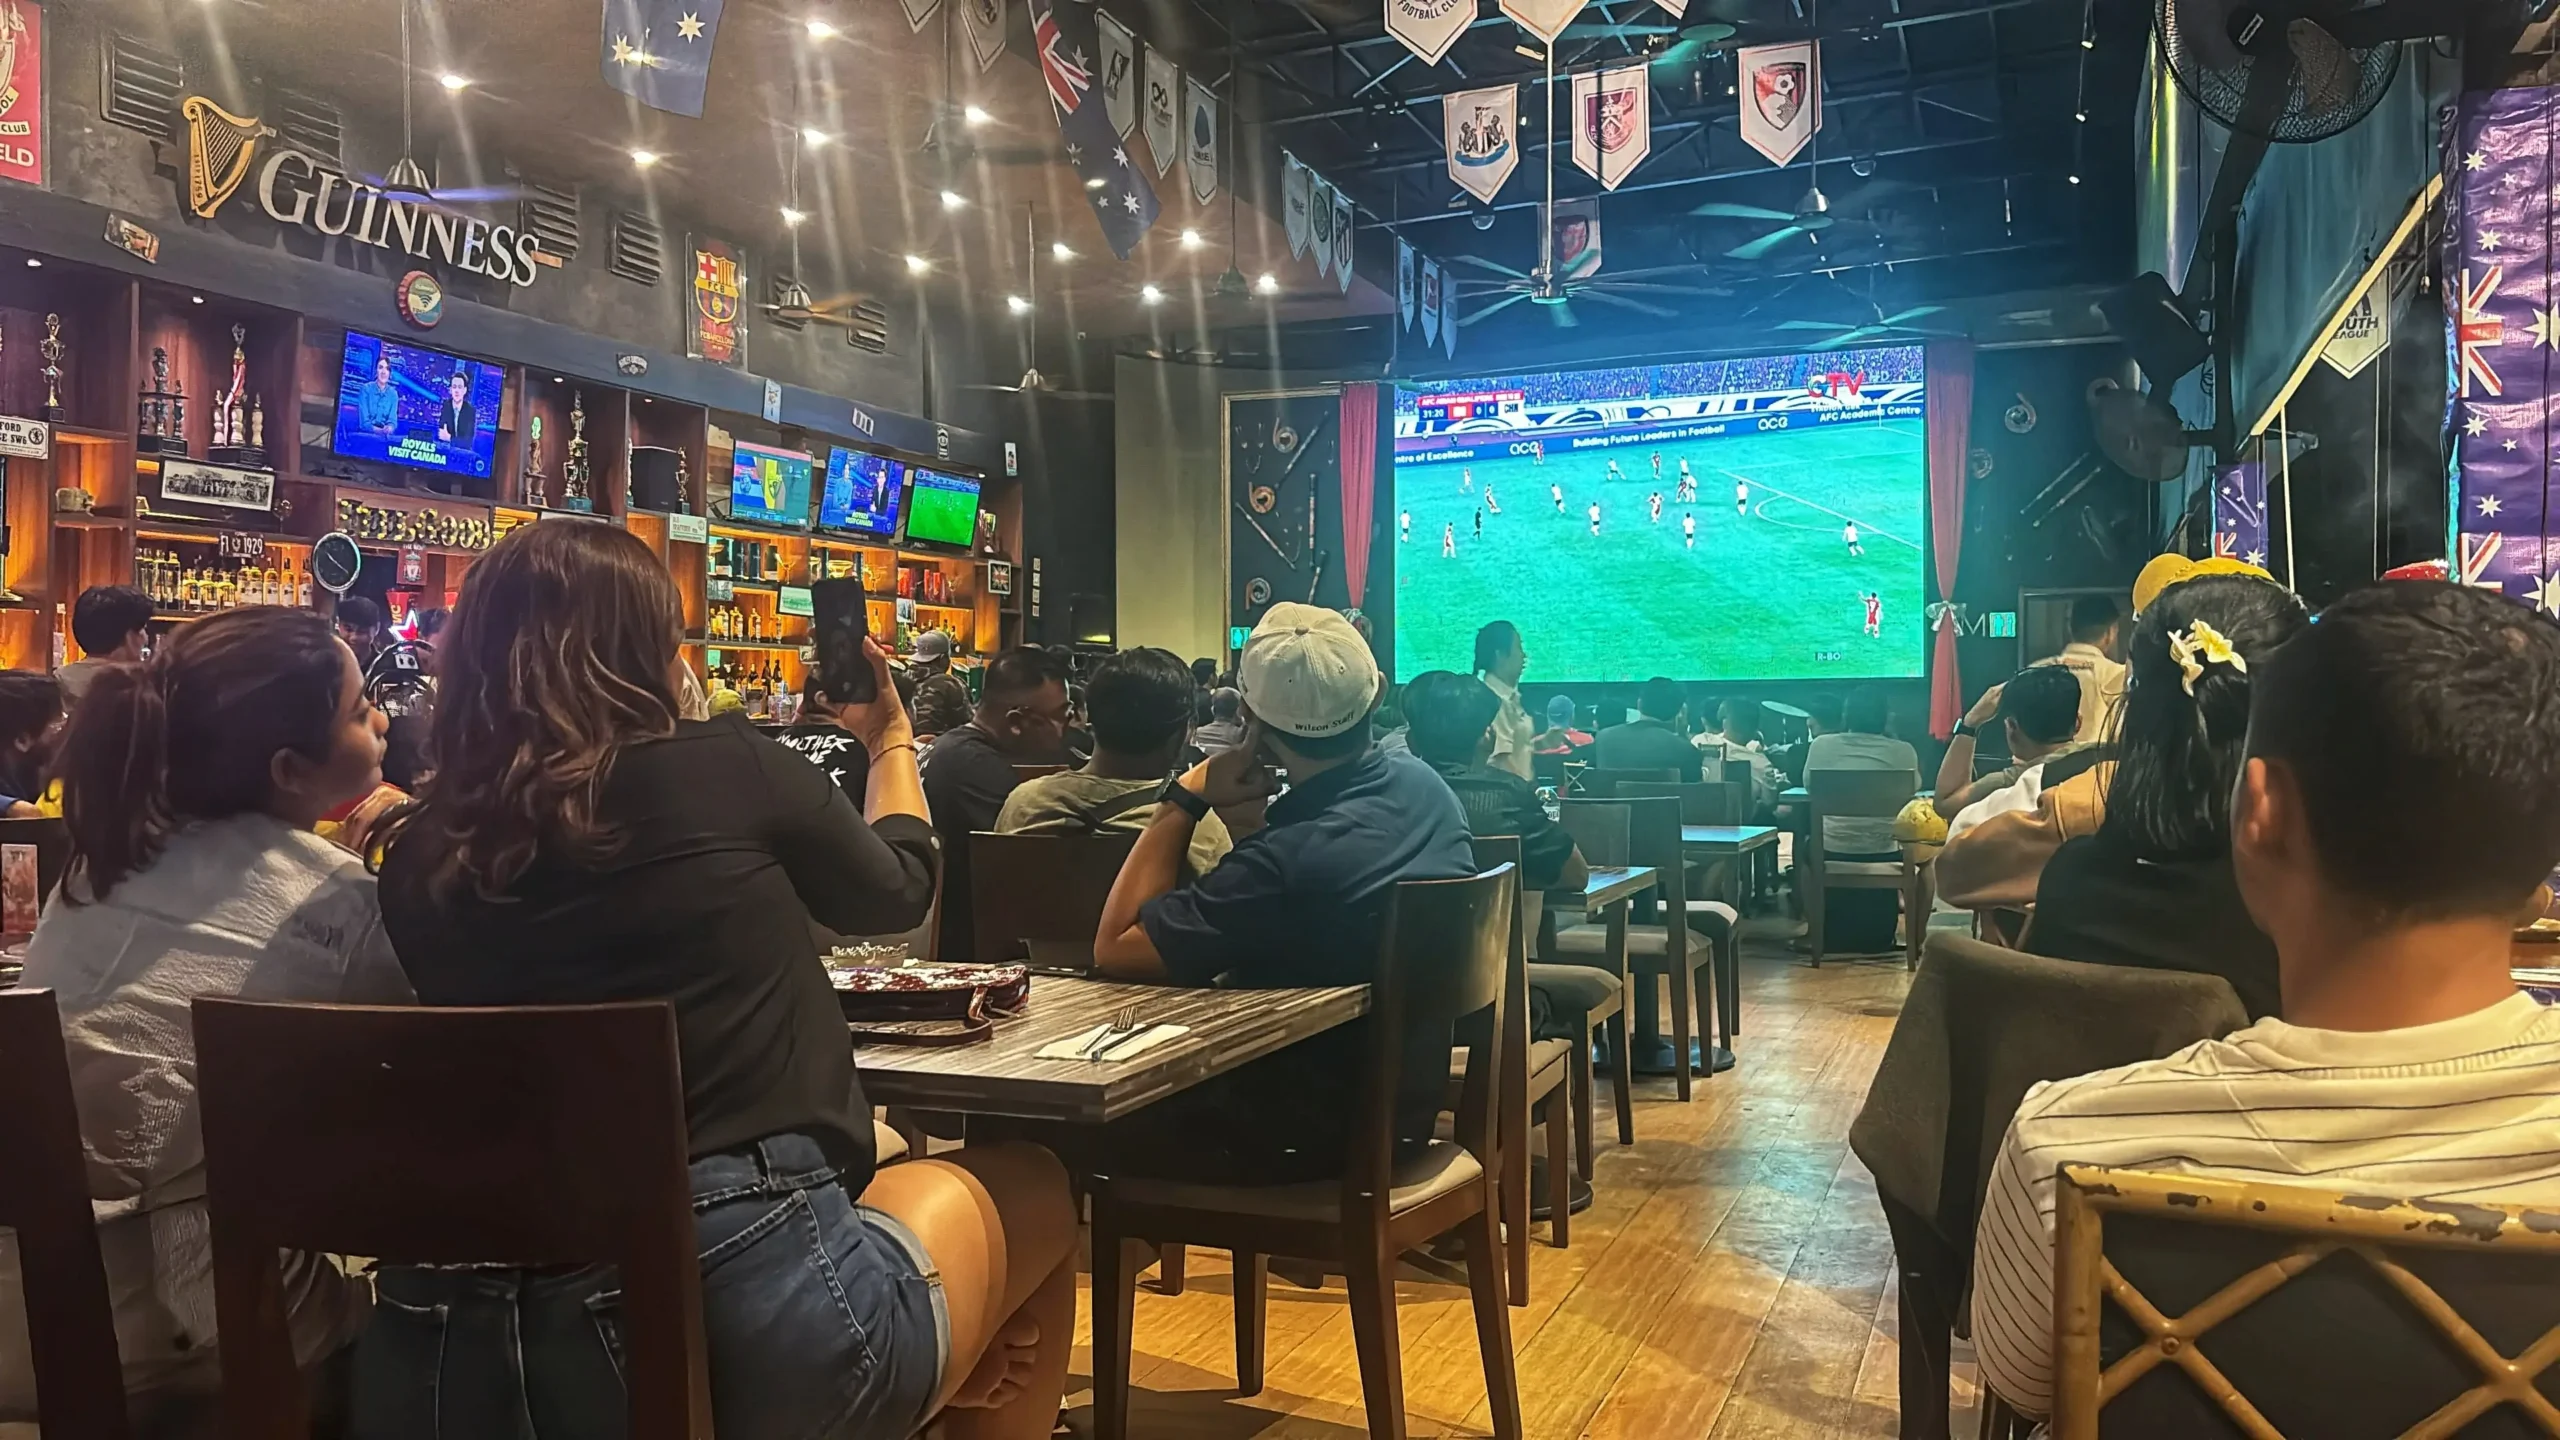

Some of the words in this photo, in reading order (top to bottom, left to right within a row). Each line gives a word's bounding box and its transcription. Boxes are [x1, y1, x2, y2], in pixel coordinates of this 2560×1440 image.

[1, 124, 28, 133] CLUB
[259, 150, 539, 287] GUINNESS
[708, 281, 725, 293] FCB
[2338, 316, 2379, 331] UTH
[2333, 330, 2370, 340] EAGUE
[1423, 409, 1444, 418] 31:20
[1820, 413, 1838, 422] AFC
[1887, 406, 1921, 415] Centre
[11, 434, 27, 445] SW6
[1573, 436, 1609, 448] Building
[1610, 433, 1639, 444] Future
[1641, 429, 1677, 441] Leaders
[1688, 424, 1725, 436] Football
[401, 438, 436, 453] ROYALS
[388, 445, 411, 458] VISIT
[410, 449, 447, 465] CANADA
[1416, 452, 1425, 462] of
[1427, 450, 1475, 461] Excellence
[243, 537, 263, 554] 1929
[1295, 723, 1328, 732] Wilson
[1331, 709, 1355, 727] Staff
